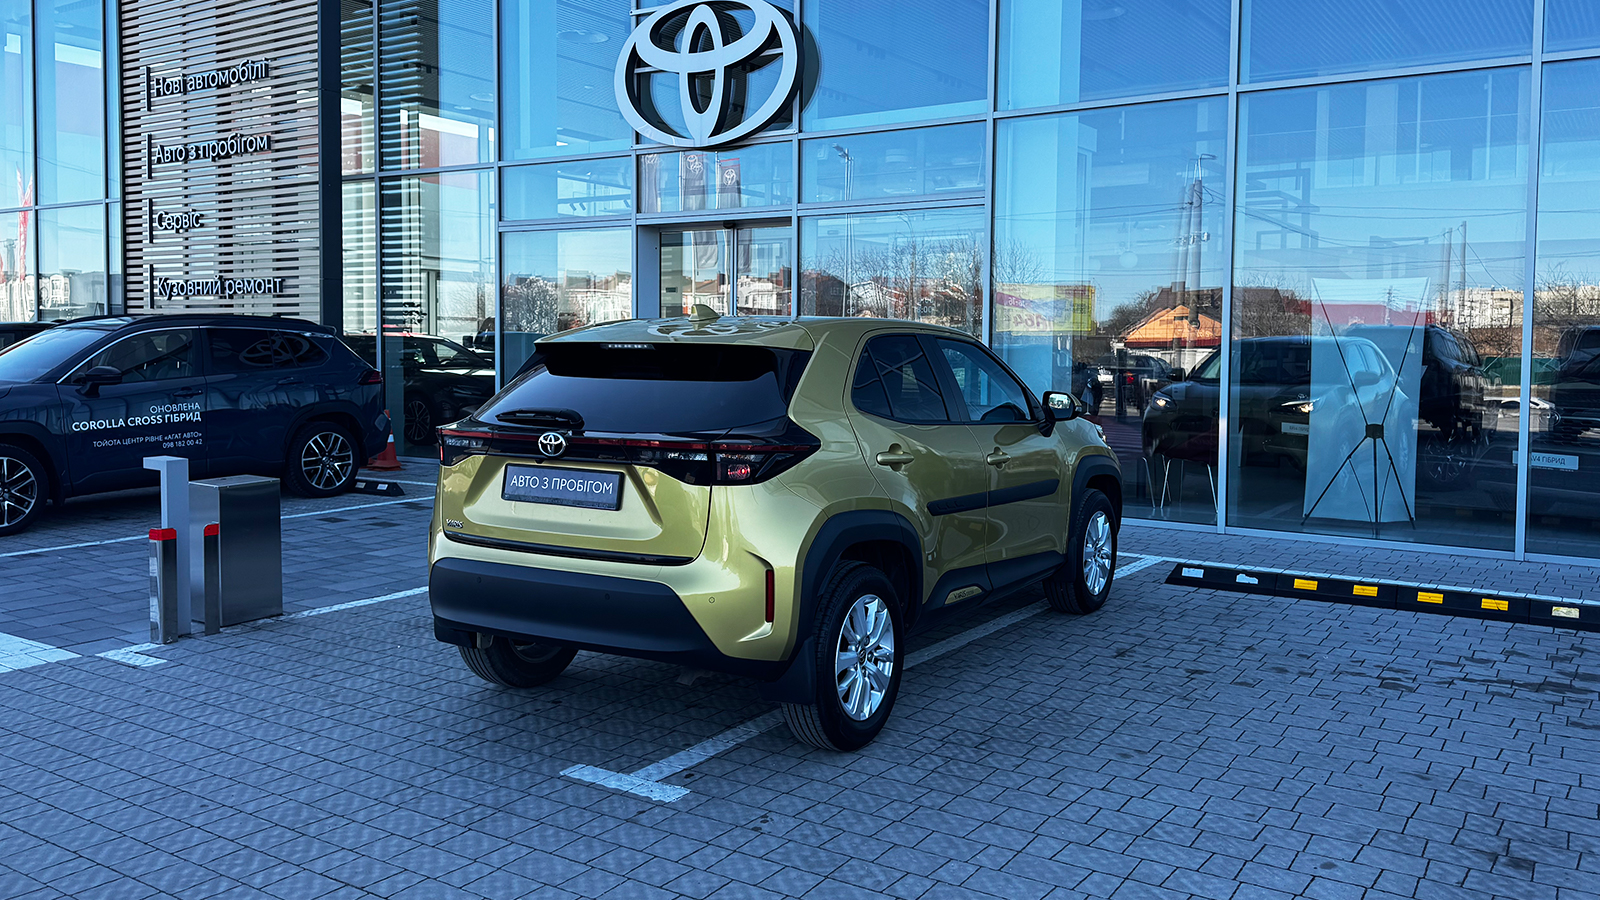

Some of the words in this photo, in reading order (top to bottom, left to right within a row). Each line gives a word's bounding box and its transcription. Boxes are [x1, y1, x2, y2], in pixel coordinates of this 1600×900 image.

[154, 73, 185, 97] Нові
[187, 57, 269, 91] автомобілі
[155, 144, 186, 163] Авто
[201, 132, 270, 162] пробігом
[156, 208, 203, 234] Сервіс
[157, 275, 222, 300] Кузовний
[225, 277, 284, 299] ремонт
[149, 402, 201, 414] ОНОВЛЕНА
[71, 418, 126, 432] COROLLA
[127, 415, 163, 427] CROSS
[164, 411, 202, 424] ГІБРИД
[93, 439, 121, 448] ТОЙОТА
[122, 436, 144, 446] ЦЕНТР
[144, 434, 163, 443] РІВНЕ
[162, 441, 175, 449] 098
[175, 440, 186, 448] 182
[186, 439, 195, 447] 00
[195, 438, 203, 446] 42
[510, 475, 540, 489] АВТО
[551, 478, 613, 495] ПРОБІГОМ
